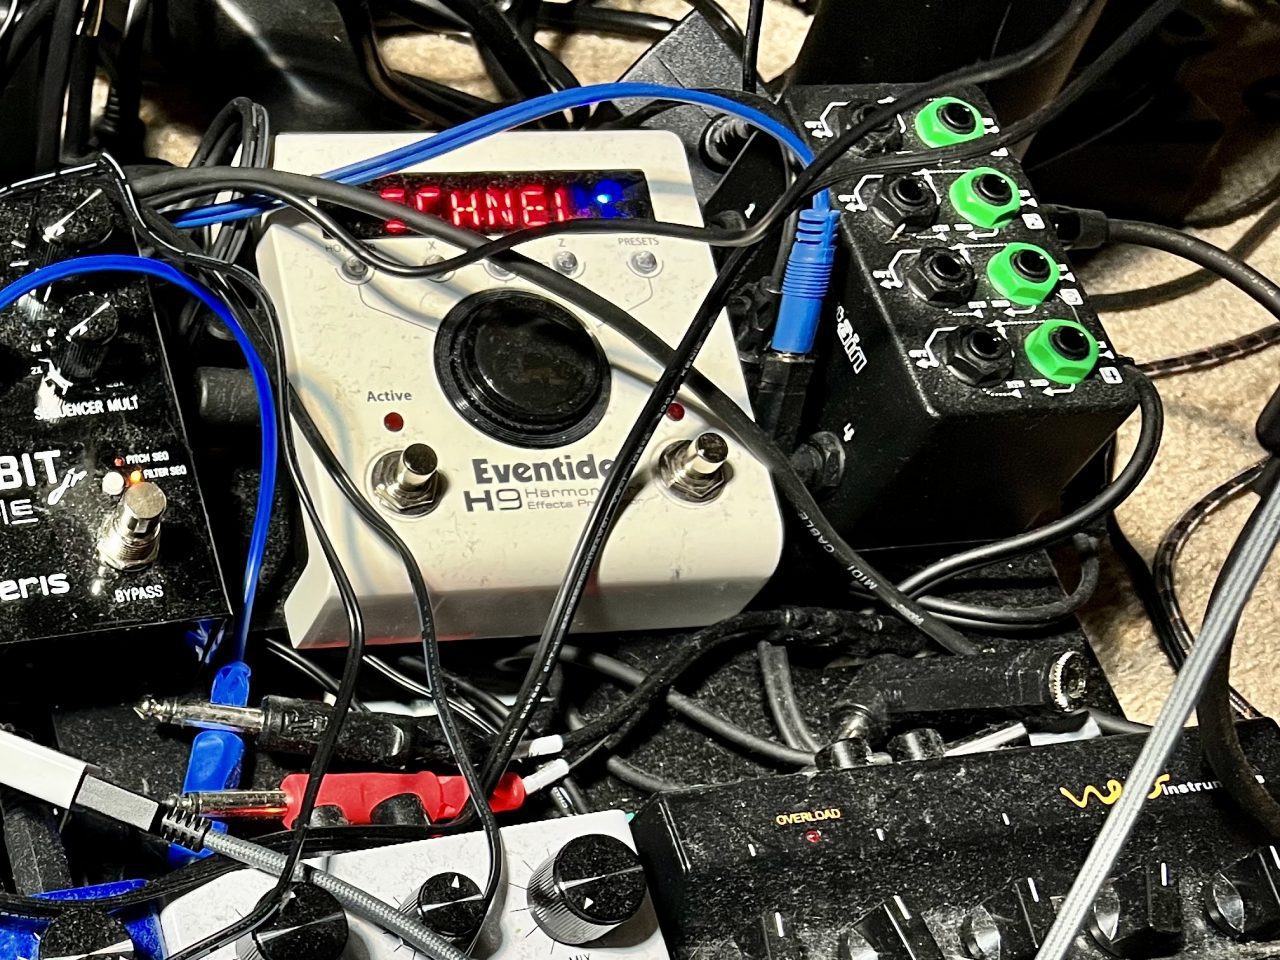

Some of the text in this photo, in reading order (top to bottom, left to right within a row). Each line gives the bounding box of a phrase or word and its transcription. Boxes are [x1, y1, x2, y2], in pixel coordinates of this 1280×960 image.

[558, 238, 567, 248] Z
[617, 236, 660, 247] PRESETS
[107, 395, 138, 411] MULT
[366, 390, 413, 403] Active
[463, 487, 600, 513] H9 Harmon
[527, 501, 574, 510] Effects
[115, 584, 163, 603] BYPASS
[775, 807, 842, 827] OVERLOAD
